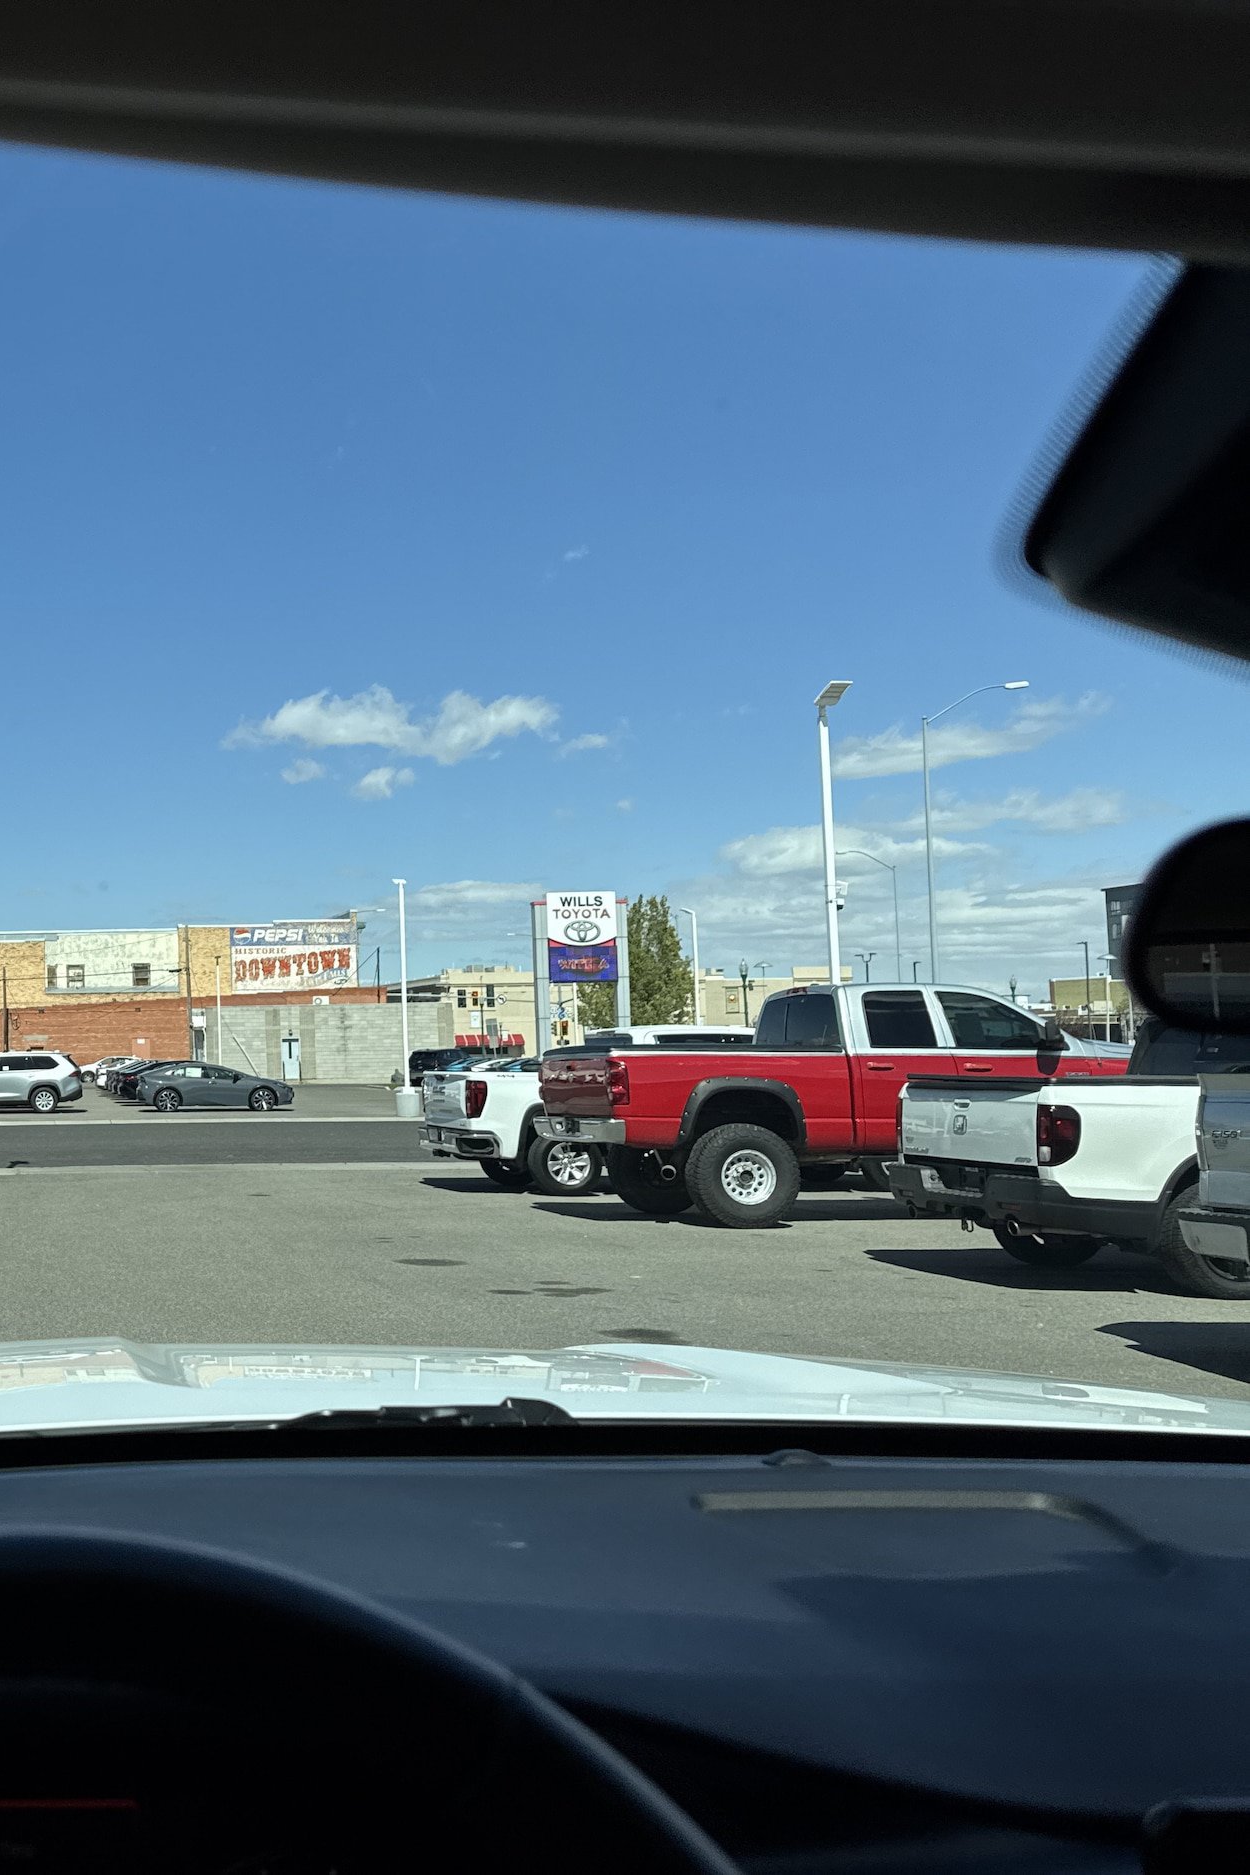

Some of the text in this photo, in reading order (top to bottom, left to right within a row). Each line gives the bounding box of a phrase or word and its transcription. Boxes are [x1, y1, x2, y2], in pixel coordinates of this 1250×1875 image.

[560, 896, 603, 907] WILLS
[552, 908, 611, 919] TOYOTA
[253, 928, 303, 942] PEPSI
[234, 947, 287, 955] HISTORIC
[234, 947, 351, 983] DOWNTOWN
